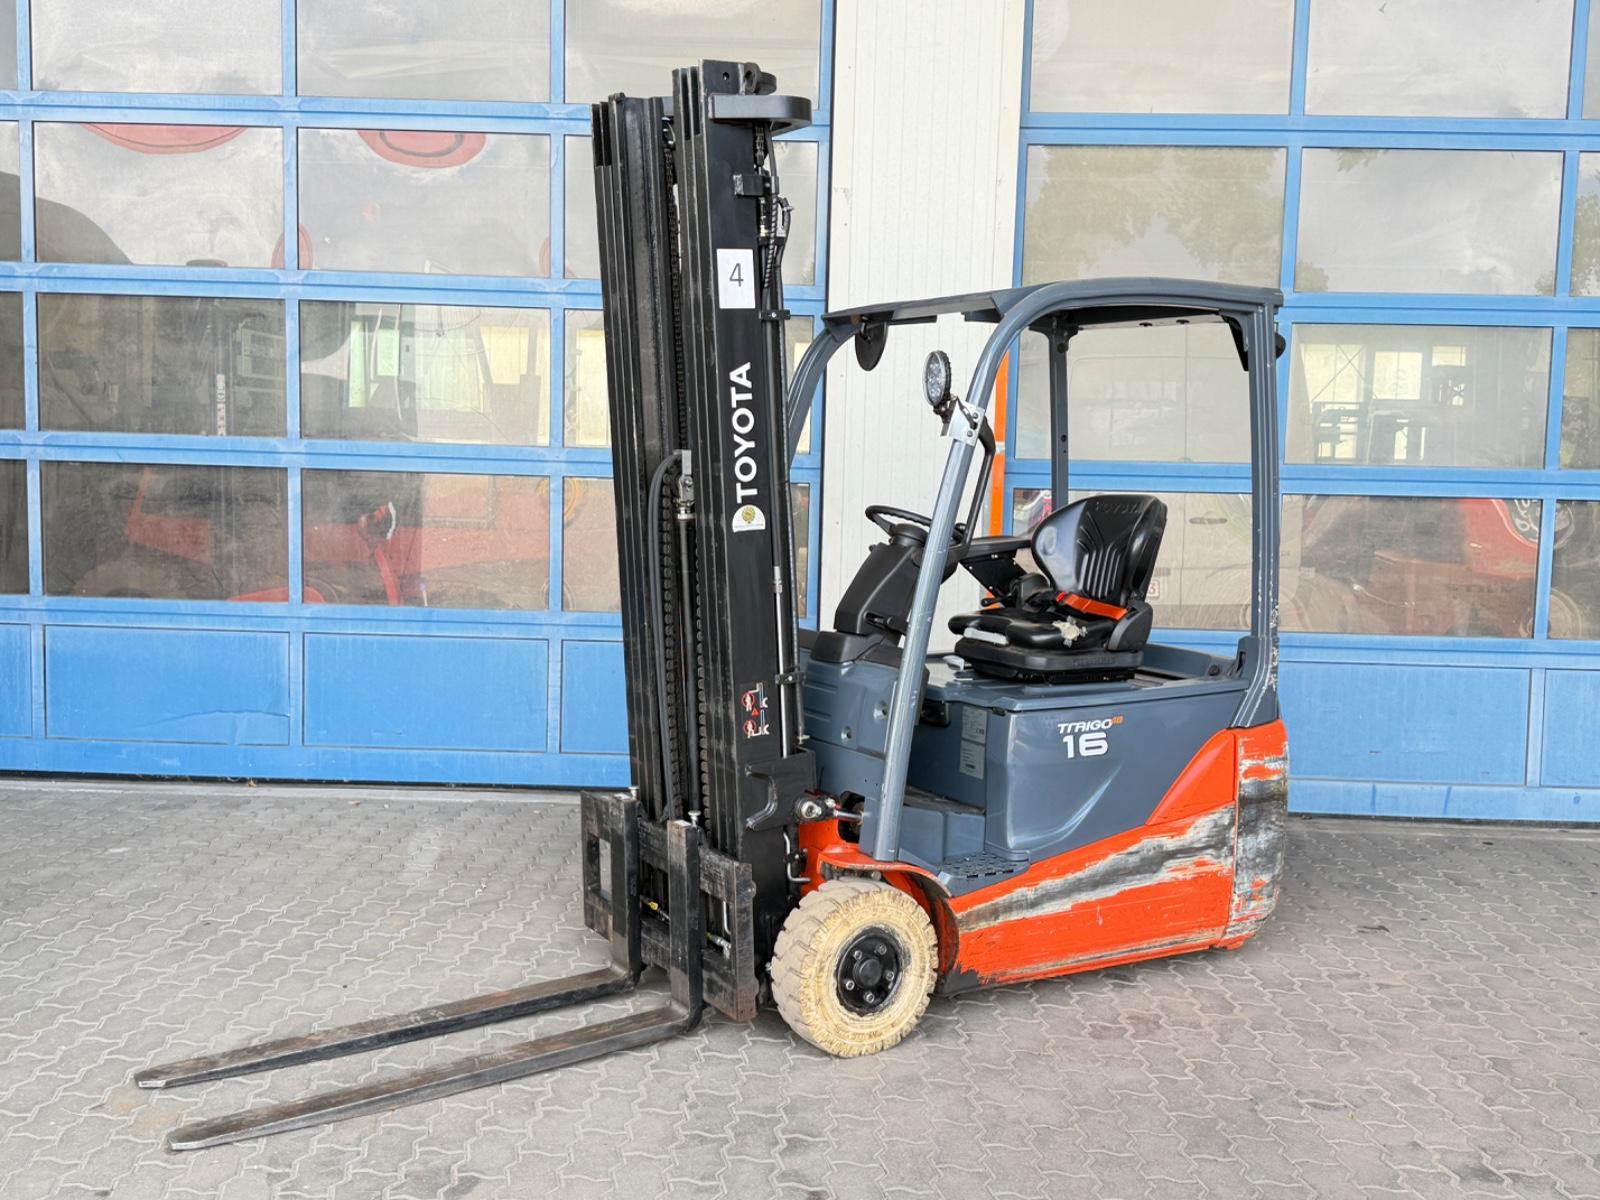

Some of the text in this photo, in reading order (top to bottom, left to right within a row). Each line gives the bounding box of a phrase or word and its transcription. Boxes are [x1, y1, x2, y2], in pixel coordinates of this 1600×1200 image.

[729, 262, 744, 287] 4
[729, 361, 758, 504] TOYOTA
[1062, 732, 1108, 759] 16
